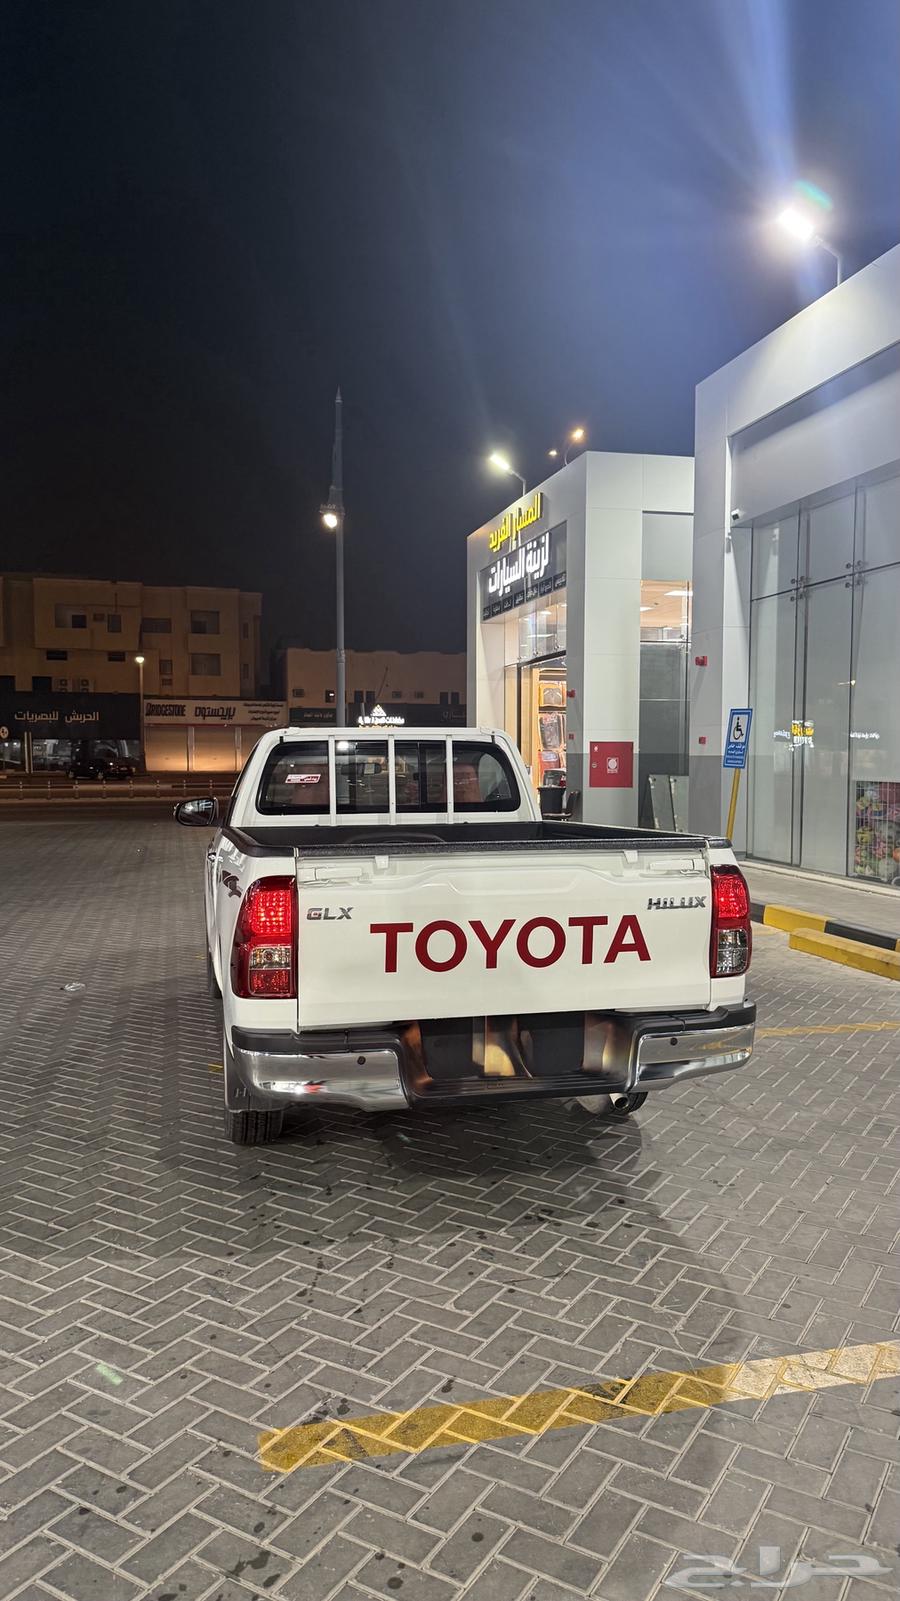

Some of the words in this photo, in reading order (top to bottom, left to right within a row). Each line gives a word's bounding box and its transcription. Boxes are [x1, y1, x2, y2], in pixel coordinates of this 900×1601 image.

[489, 513, 511, 553] الفريد
[512, 492, 542, 542] المسار
[488, 546, 526, 597] السيارات
[526, 531, 549, 580] لزينة
[145, 703, 186, 717] BRIDGESTONE
[307, 907, 354, 920] GLX
[647, 896, 707, 910] HILUX
[370, 914, 652, 973] TOYOTA
